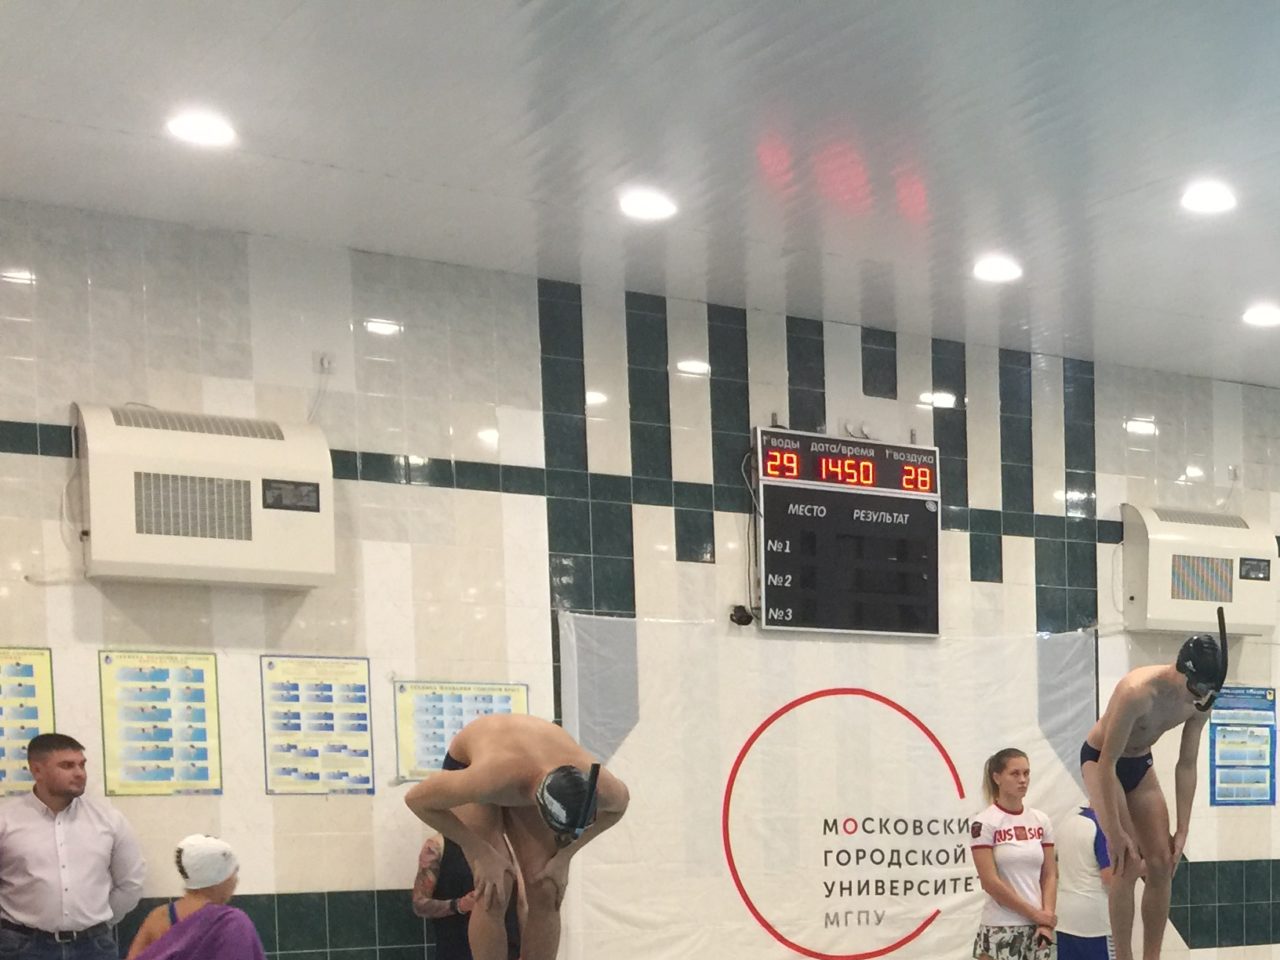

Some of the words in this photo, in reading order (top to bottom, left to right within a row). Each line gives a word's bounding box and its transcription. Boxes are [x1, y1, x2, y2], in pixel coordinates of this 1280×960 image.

[810, 441, 875, 457] дата/время
[767, 451, 798, 477] 29
[820, 458, 874, 485] 1450
[902, 466, 930, 490] 28
[788, 503, 827, 518] МЕСТО
[853, 509, 910, 525] РЕЗУЛЬТАТ
[767, 539, 791, 553] №1
[767, 573, 792, 588] №2
[768, 607, 793, 621] №3
[823, 817, 971, 836] МОСКОВСКИ
[823, 844, 966, 868] ГОРОДСКОЙ
[823, 875, 981, 898] УНИВЕРСИТЕ
[824, 909, 886, 928] МГПУ
